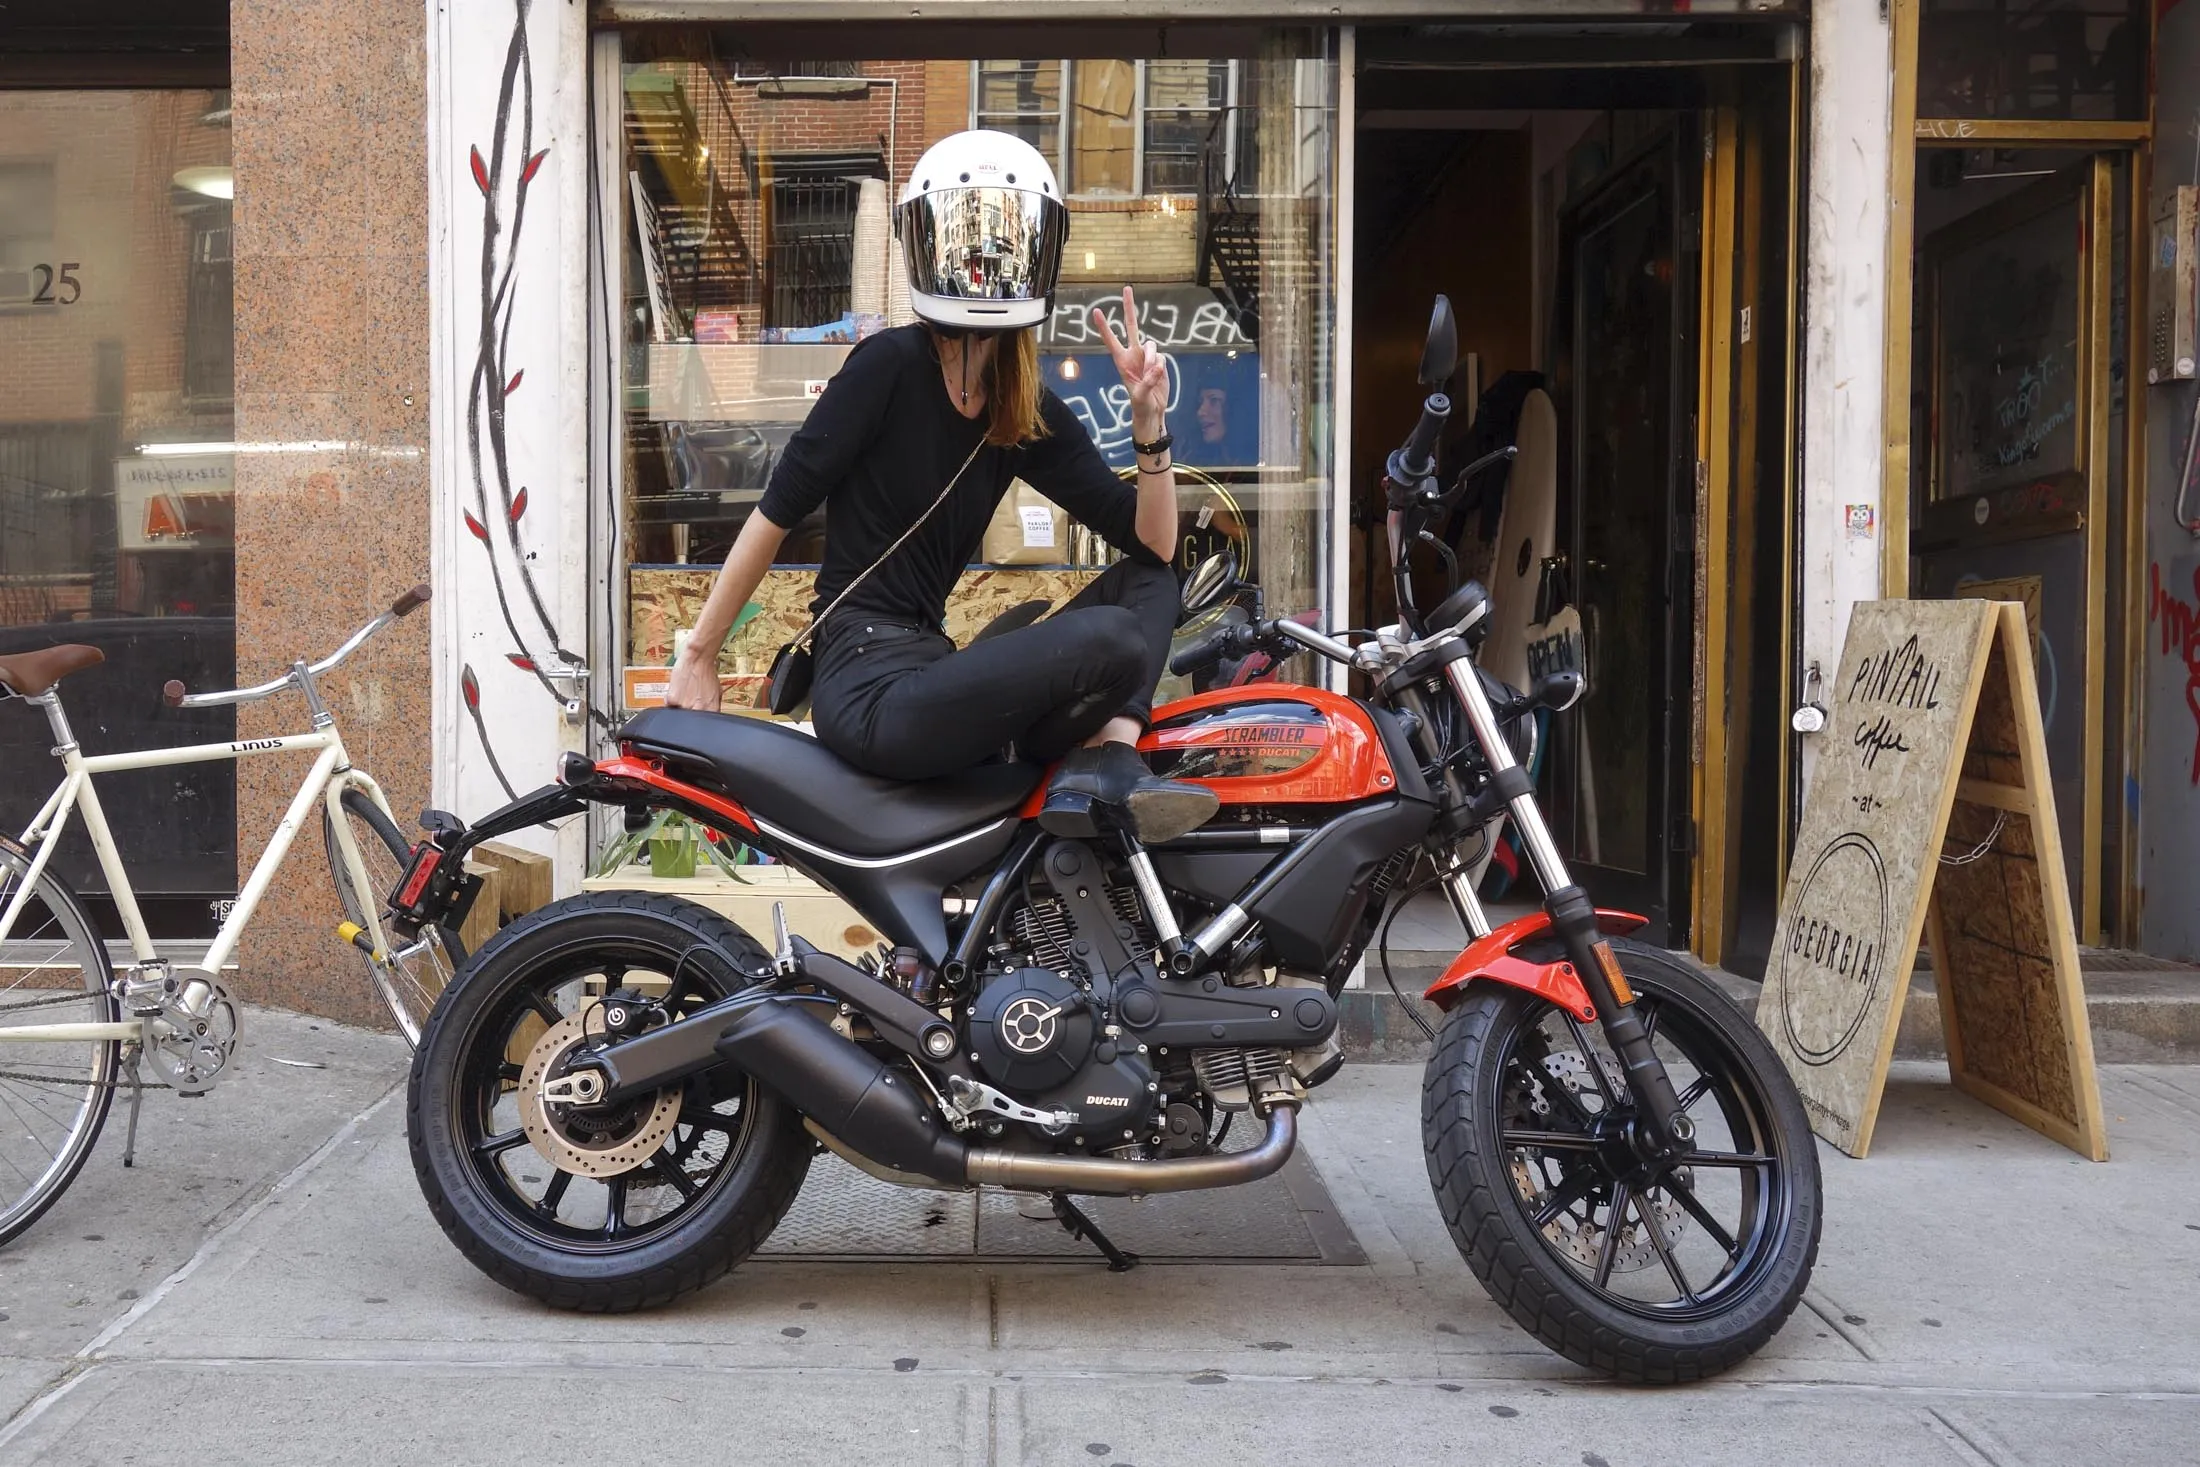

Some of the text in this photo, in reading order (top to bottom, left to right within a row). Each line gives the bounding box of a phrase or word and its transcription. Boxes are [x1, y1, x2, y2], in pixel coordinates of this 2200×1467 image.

[32, 263, 81, 305] 25
[1848, 634, 1940, 710] PINTAIL
[1223, 727, 1305, 743] SCRAMBLER
[1258, 748, 1301, 757] DUCATI
[1793, 916, 1873, 986] GEORGIA
[1086, 1095, 1129, 1107] DUCATI
